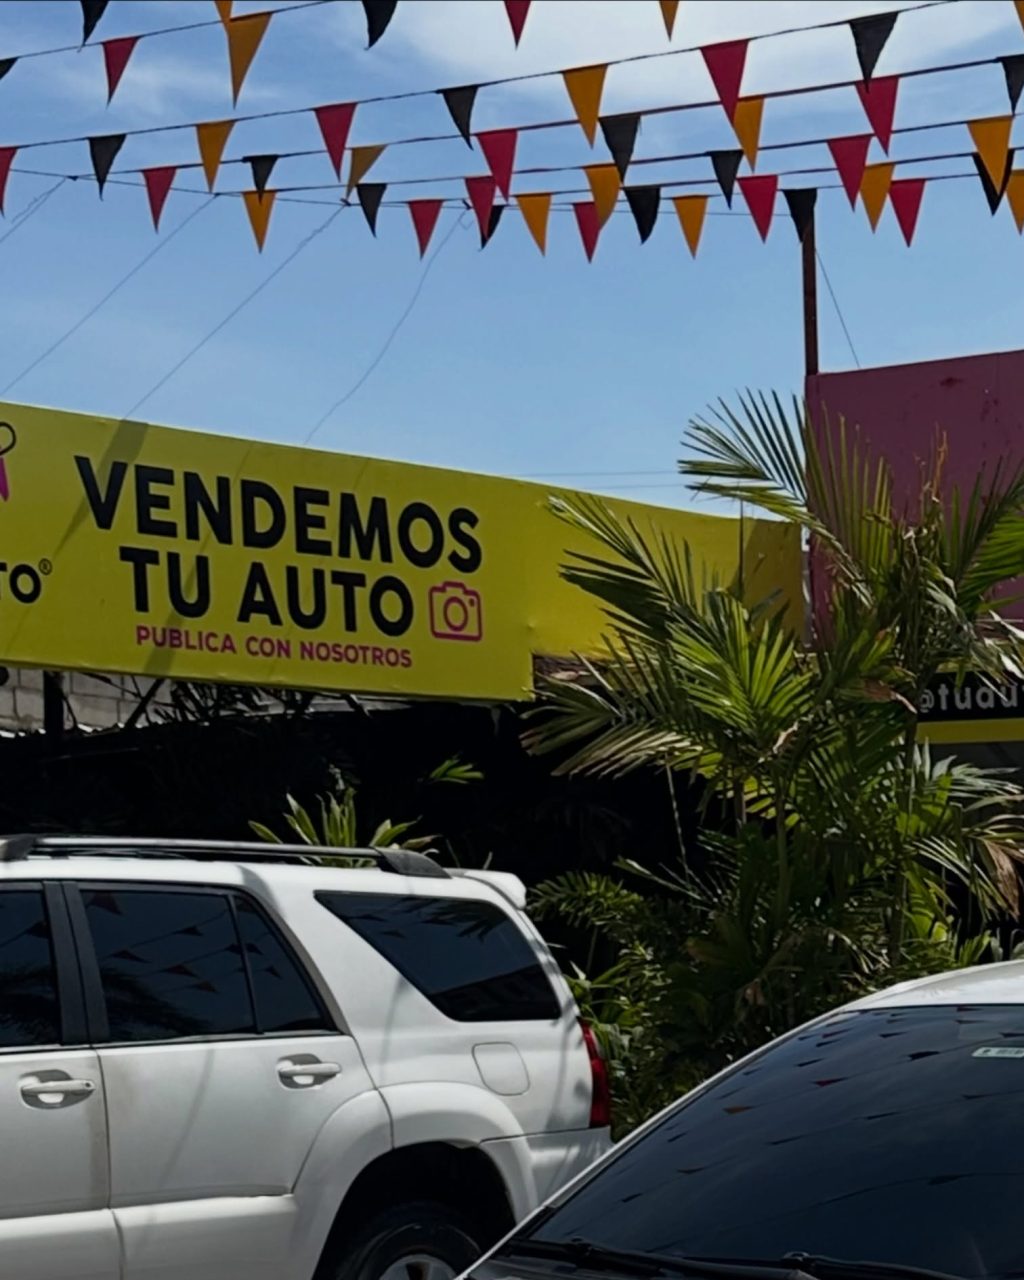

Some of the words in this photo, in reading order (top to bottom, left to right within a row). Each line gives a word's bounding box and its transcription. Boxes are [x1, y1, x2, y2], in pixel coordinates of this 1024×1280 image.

[74, 455, 483, 574] VENDEMOS
[119, 546, 211, 618] TU
[237, 562, 414, 637] AUTO
[136, 625, 237, 655] PUBLICA
[245, 636, 291, 659] CON
[300, 641, 412, 668] NOSOTROS
